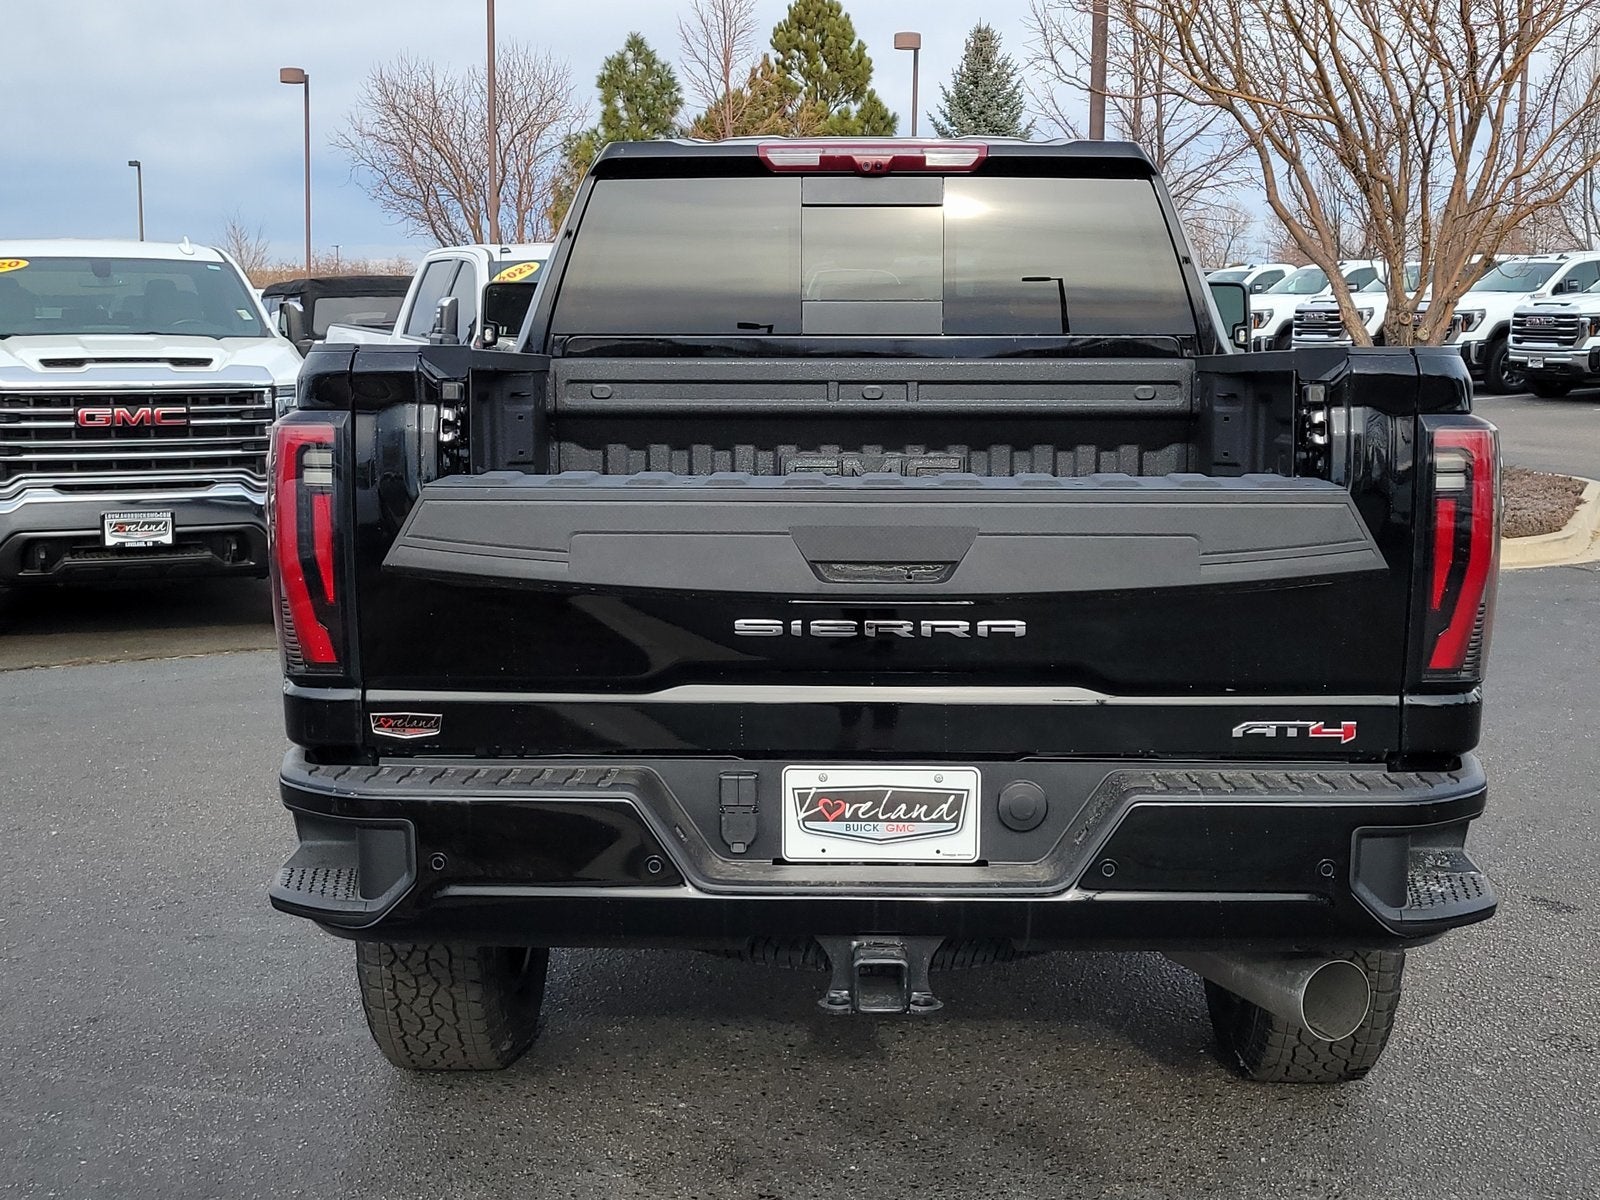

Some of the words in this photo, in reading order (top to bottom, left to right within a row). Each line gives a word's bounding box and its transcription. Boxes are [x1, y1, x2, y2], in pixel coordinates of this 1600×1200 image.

[78, 407, 187, 426] GMC
[734, 619, 1027, 638] SIERRA
[1232, 721, 1357, 744] AT4
[798, 787, 958, 822] Loveland
[845, 823, 880, 833] BUICK
[885, 823, 916, 833] GMC
